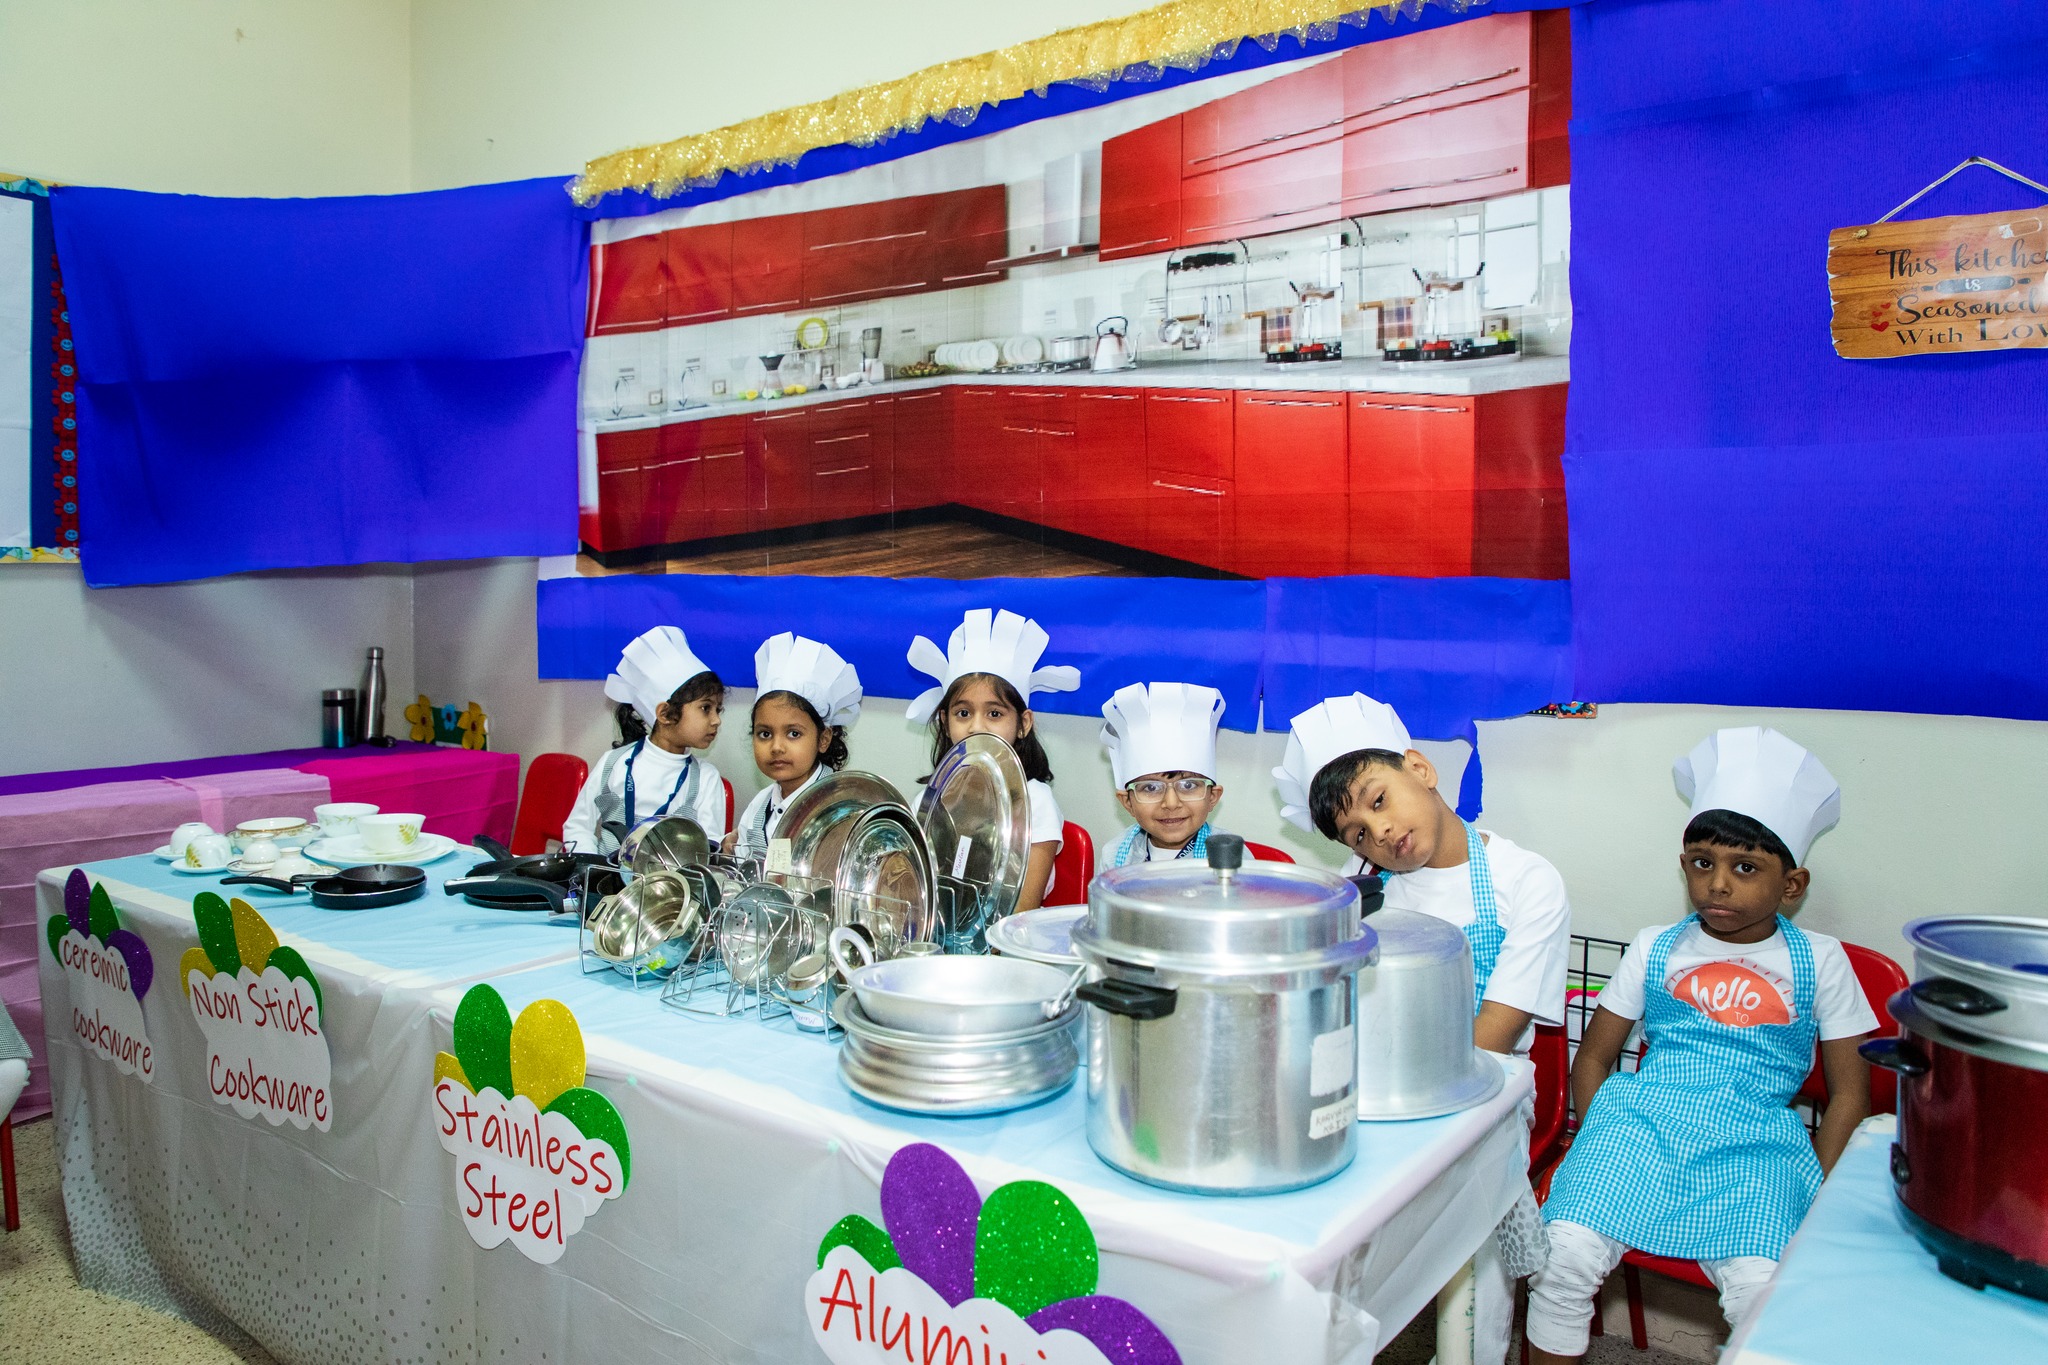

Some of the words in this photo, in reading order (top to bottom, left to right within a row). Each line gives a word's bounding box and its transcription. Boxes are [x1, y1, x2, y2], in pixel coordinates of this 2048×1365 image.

[1876, 248, 1939, 280] This
[1955, 238, 2048, 275] kitche
[1964, 278, 1983, 291] is
[1896, 286, 2042, 325] Seasoned
[1893, 327, 1963, 346] With
[63, 938, 128, 992] ceremic
[192, 982, 242, 1024] Non
[248, 982, 318, 1036] Stick
[1690, 975, 1762, 1015] hello
[1734, 1011, 1750, 1025] TO
[73, 1007, 153, 1074] cookware
[210, 1055, 328, 1122] Cookware
[436, 1084, 613, 1194] Stainless
[463, 1163, 563, 1245] Steel
[819, 1267, 1047, 1365] Alumi
